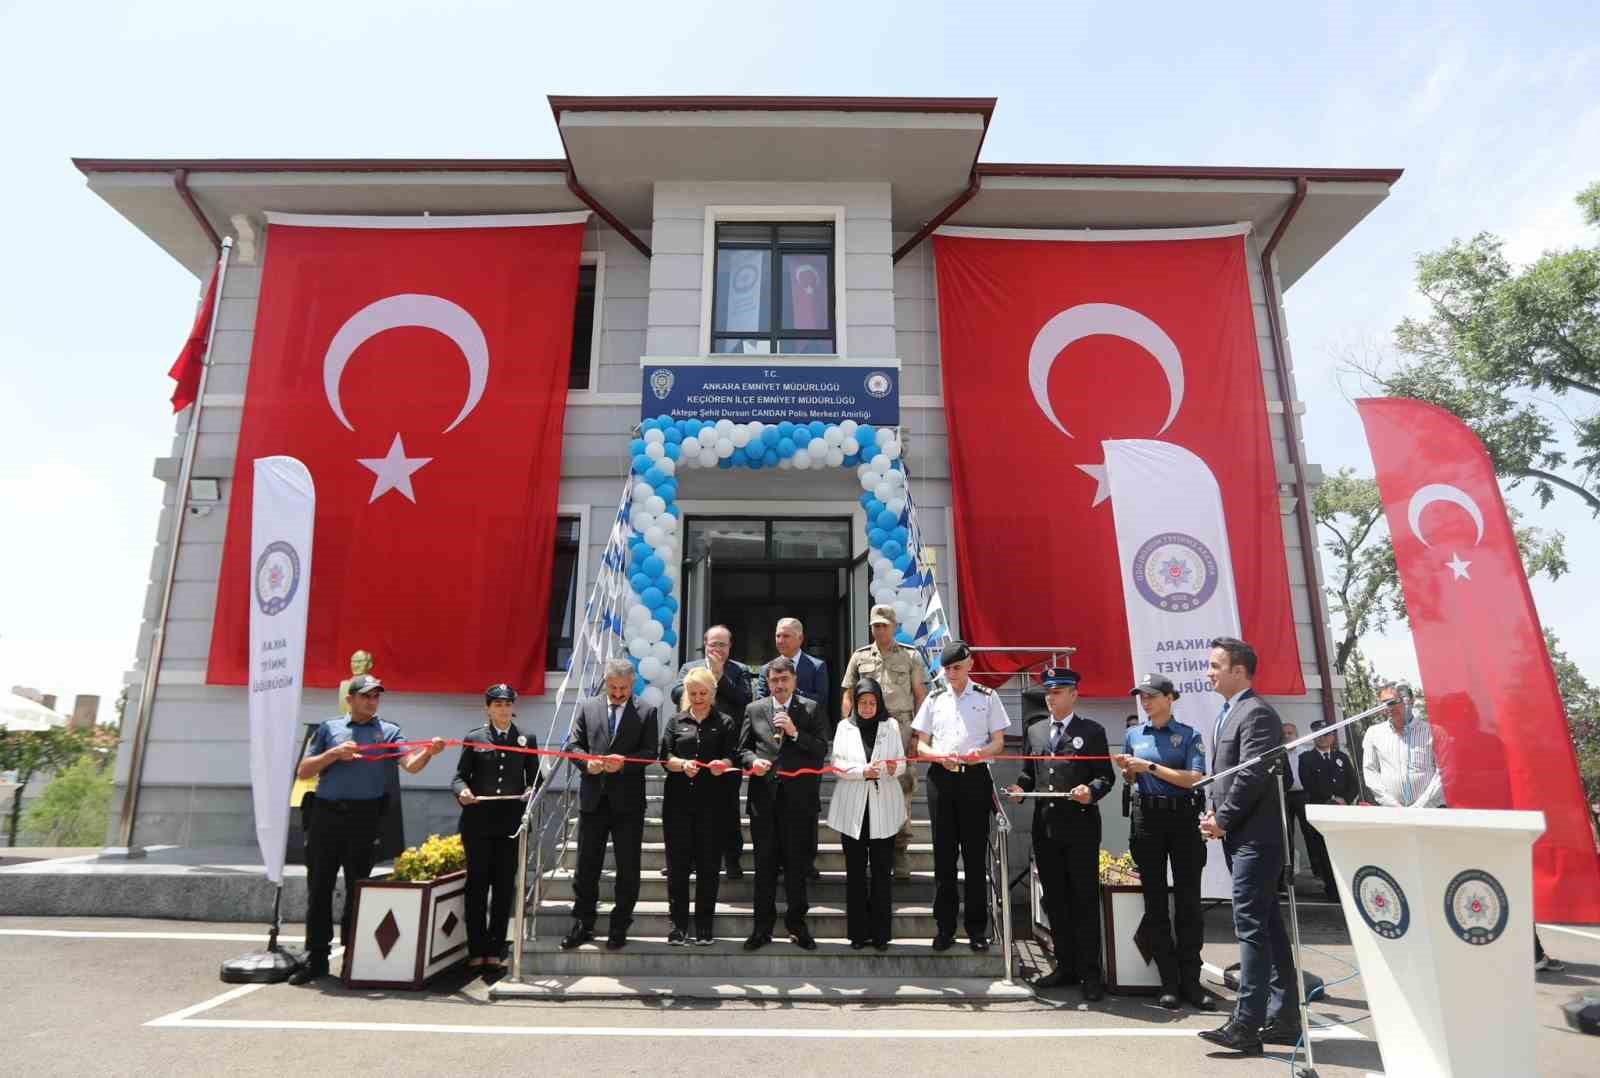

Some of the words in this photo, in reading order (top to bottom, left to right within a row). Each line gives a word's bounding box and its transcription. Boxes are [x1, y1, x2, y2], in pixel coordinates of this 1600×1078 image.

[703, 383, 741, 391] ANKARA
[742, 382, 780, 391] EMNİYET
[735, 394, 755, 404] İLÇE
[757, 394, 796, 404] EMNİYET
[671, 408, 698, 418] Aktepe
[700, 408, 720, 417] Şehit
[721, 408, 750, 417] Dursun
[751, 409, 787, 418] CANDAN
[788, 410, 808, 418] Polis
[810, 410, 840, 418] Merkezi
